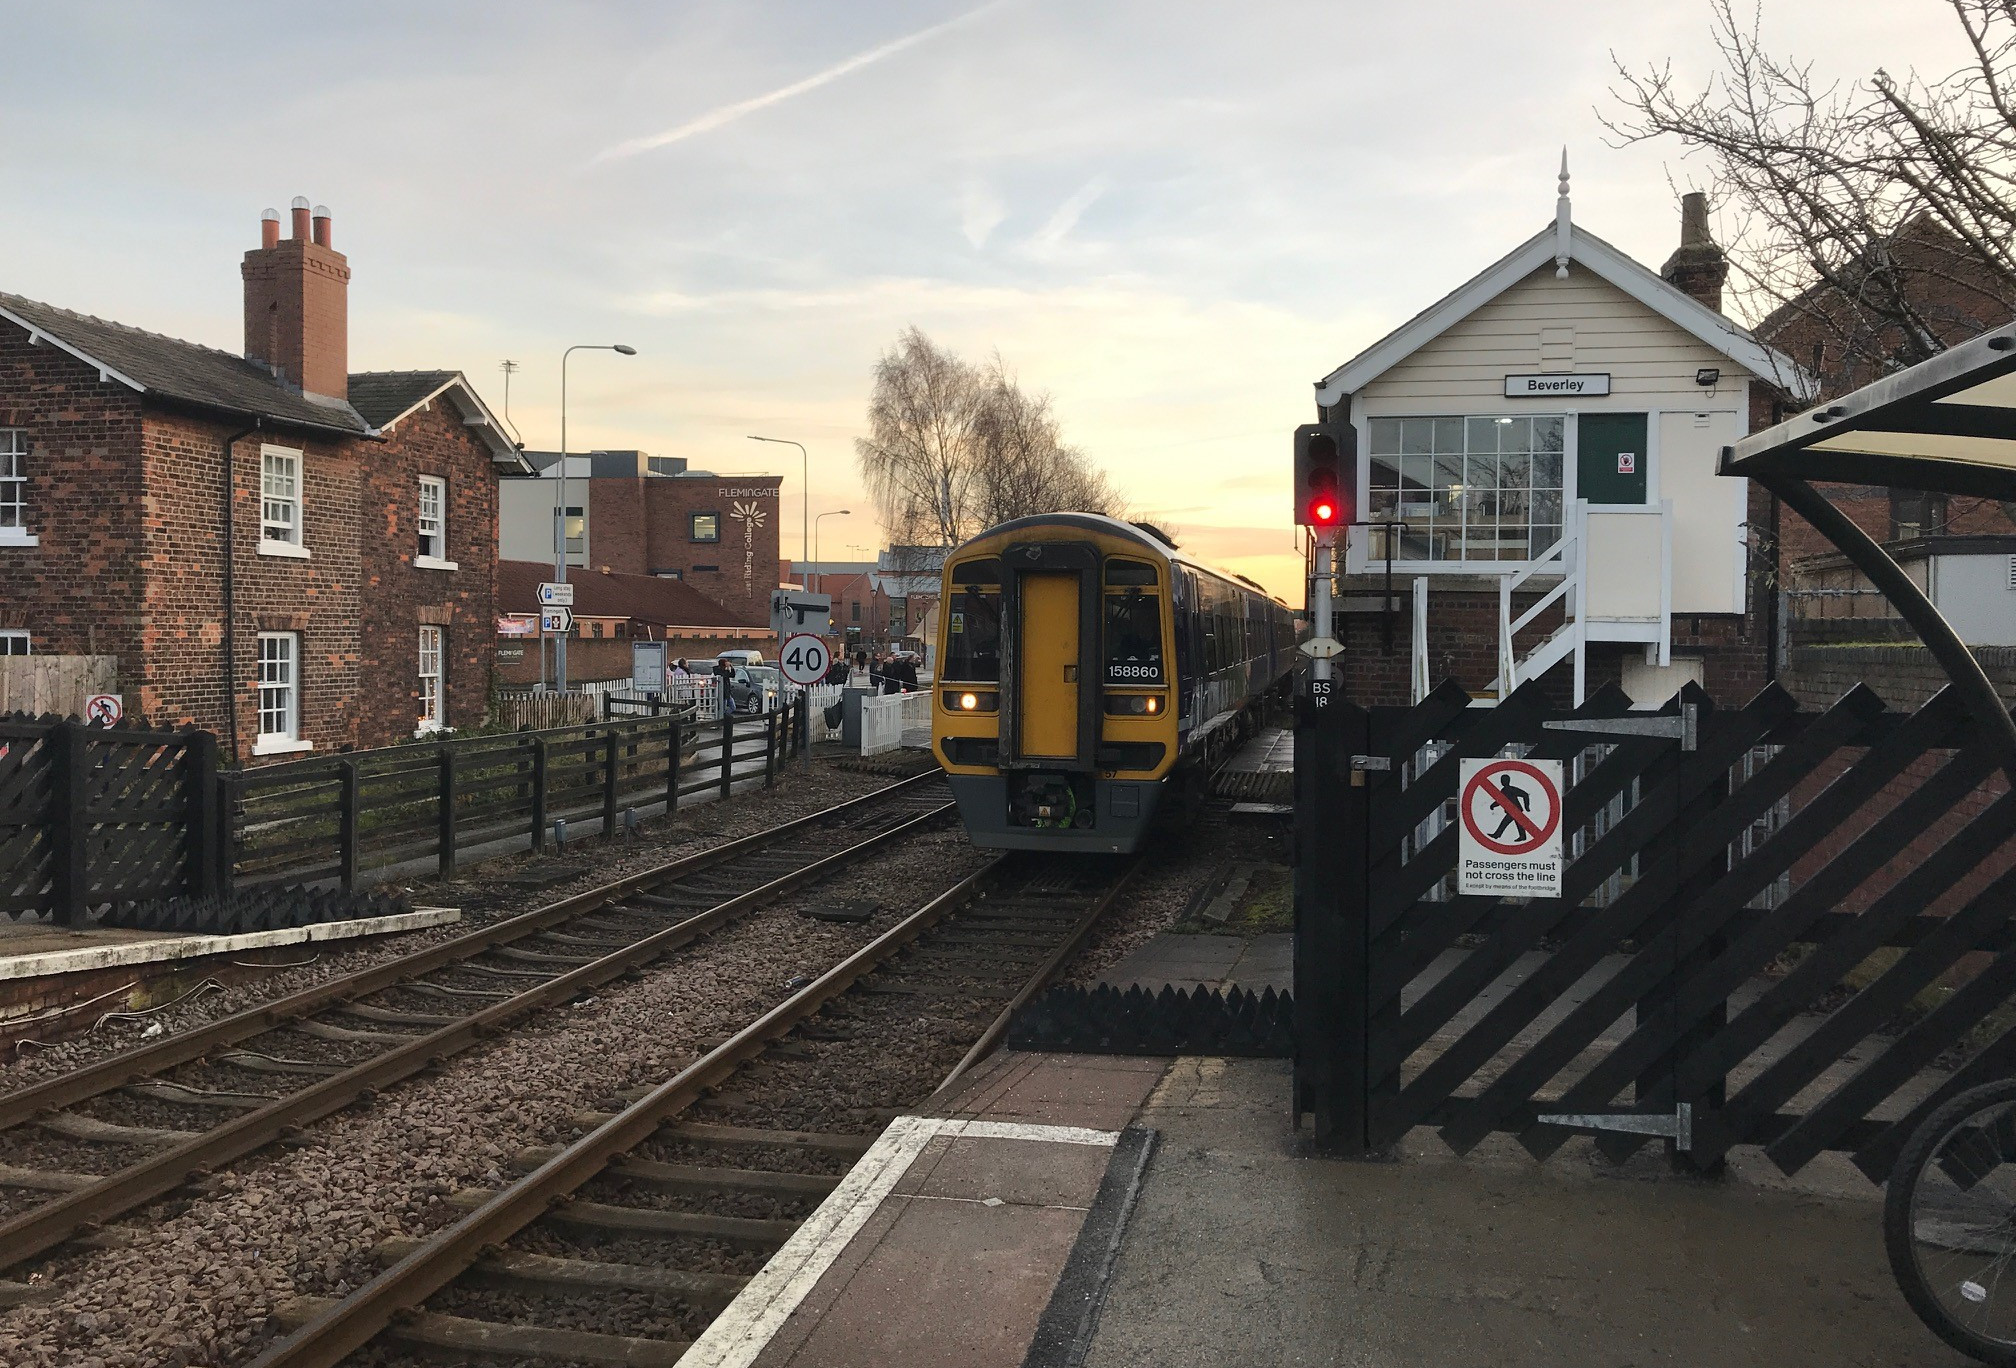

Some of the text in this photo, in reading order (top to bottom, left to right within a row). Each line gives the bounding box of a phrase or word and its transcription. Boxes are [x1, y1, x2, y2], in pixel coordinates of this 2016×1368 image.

[1528, 379, 1584, 392] Beverley
[744, 517, 754, 550] College
[744, 551, 753, 580] Riding
[786, 647, 822, 671] 40
[1109, 666, 1159, 678] 158860
[1313, 682, 1331, 694] BS
[1316, 696, 1328, 708] 18
[1465, 860, 1556, 871] Passengers must
[1465, 871, 1483, 879] not
[1517, 872, 1535, 881] the
[1536, 872, 1556, 881] line
